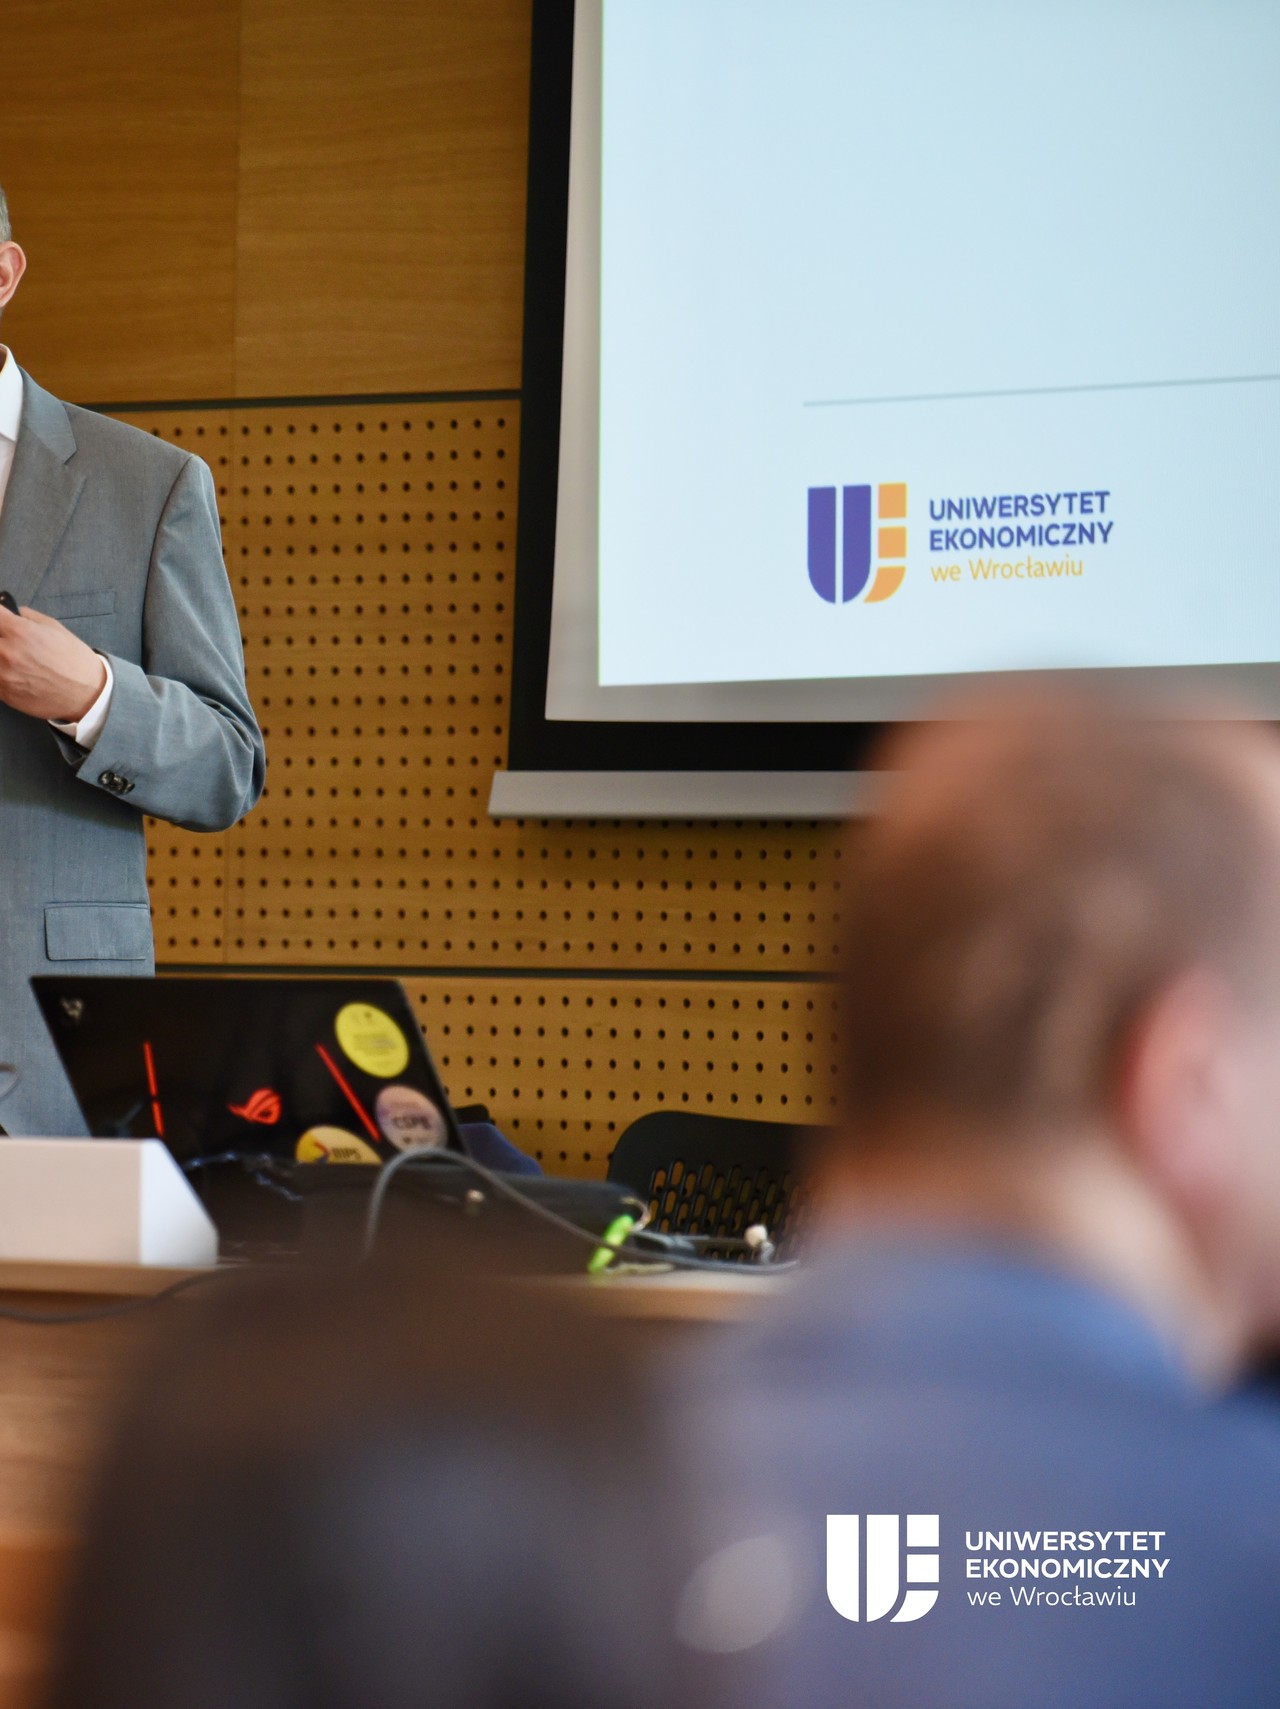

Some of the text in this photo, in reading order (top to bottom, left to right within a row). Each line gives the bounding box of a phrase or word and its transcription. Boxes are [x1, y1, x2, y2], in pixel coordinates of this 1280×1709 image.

[929, 490, 1111, 521] UNIWERSYTET
[929, 521, 1114, 551] EKONOMICZNY
[930, 554, 1083, 582] we Wrocławiu
